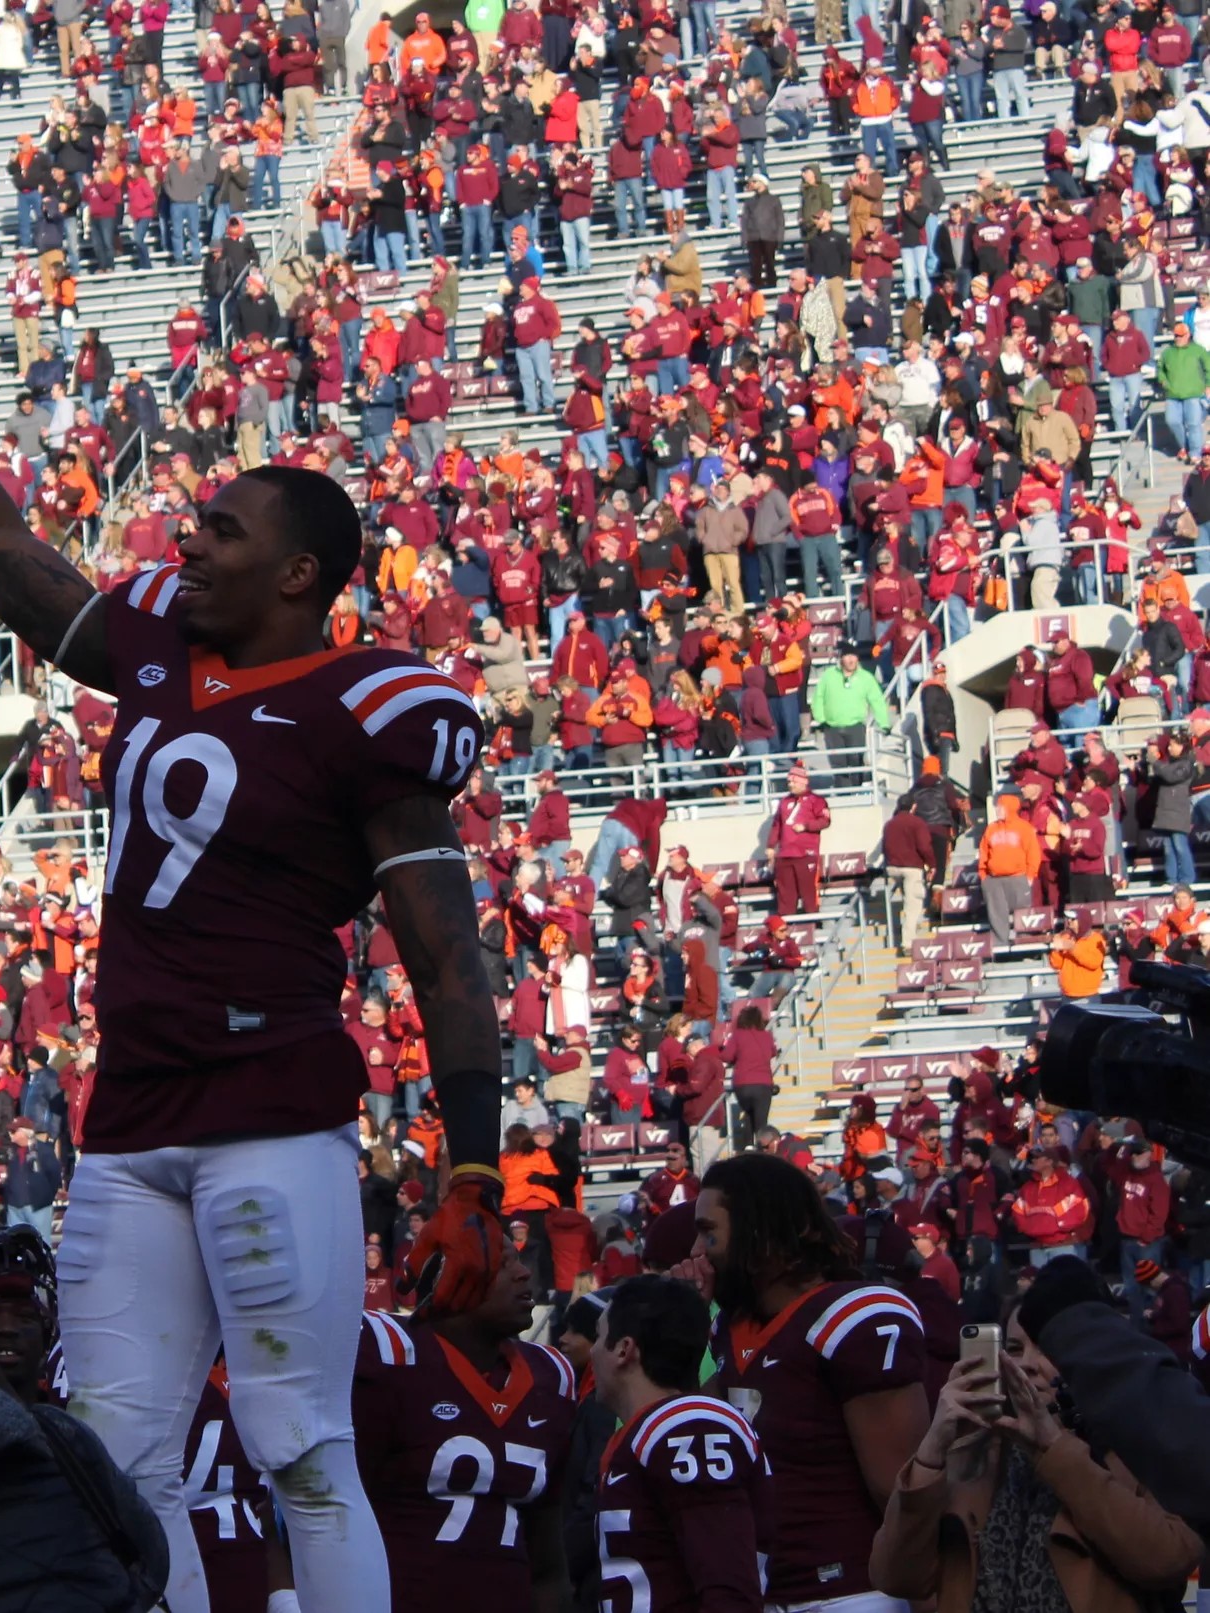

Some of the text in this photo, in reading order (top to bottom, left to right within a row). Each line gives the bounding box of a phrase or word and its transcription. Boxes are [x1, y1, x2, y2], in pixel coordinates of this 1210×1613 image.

[1177, 223, 1193, 233] VT
[1189, 256, 1208, 266] VT
[377, 275, 392, 285] VT
[1184, 276, 1202, 287] VT
[976, 305, 987, 324] 5
[463, 384, 481, 394] VT
[816, 609, 837, 620] VT
[810, 633, 829, 644] VT
[141, 667, 166, 682] ACC
[204, 675, 230, 694] VT
[427, 719, 477, 786] 19
[103, 716, 237, 909] 19
[836, 859, 859, 871] VT
[950, 896, 969, 908] VT
[1022, 913, 1046, 927] VT
[920, 945, 943, 959] VT
[962, 942, 984, 955] VT
[905, 970, 929, 984] VT
[950, 967, 974, 980] VT
[590, 995, 615, 1009] VT
[842, 1068, 866, 1081] VT
[883, 1064, 908, 1079] VT
[926, 1061, 950, 1076] VT
[602, 1132, 626, 1146] VT
[646, 1129, 670, 1143] VT
[669, 1184, 687, 1206] 4
[742, 1349, 753, 1360] VT
[876, 1325, 900, 1370] 7
[434, 1404, 457, 1416] ACC
[492, 1403, 507, 1414] VT
[667, 1434, 734, 1483] 35
[427, 1435, 546, 1546] 97
